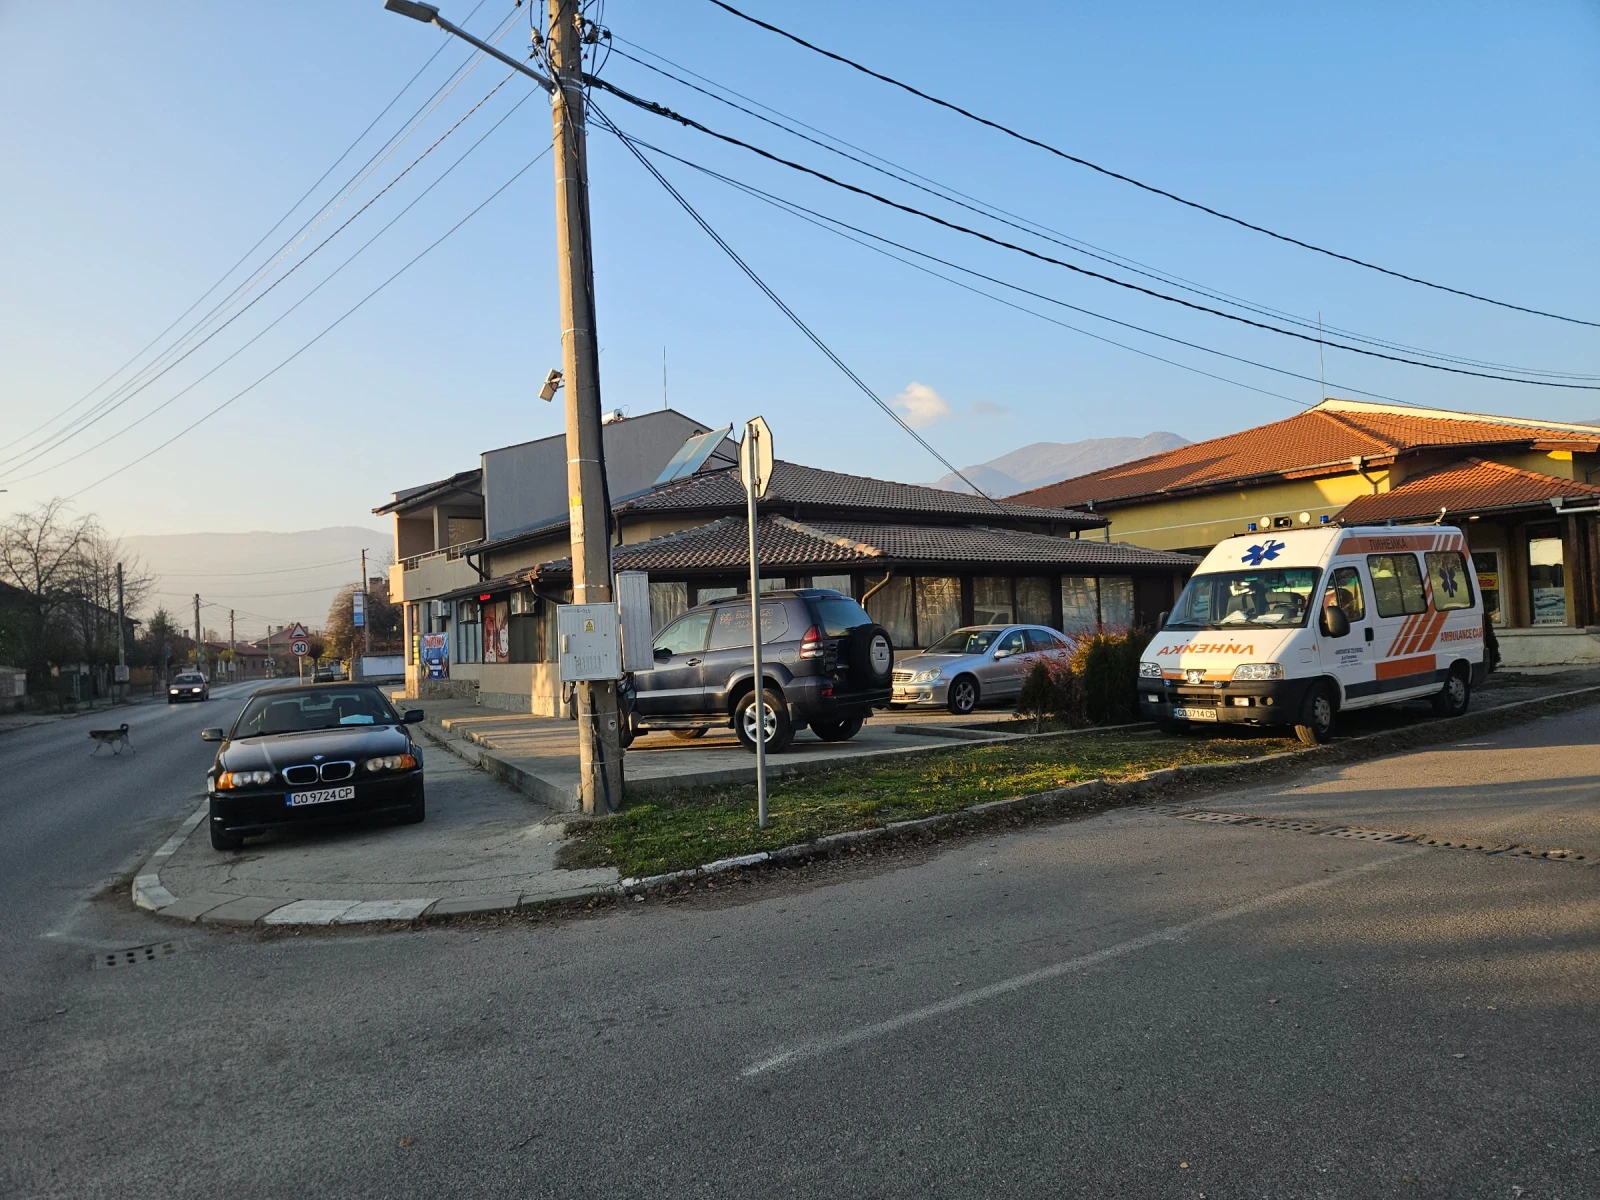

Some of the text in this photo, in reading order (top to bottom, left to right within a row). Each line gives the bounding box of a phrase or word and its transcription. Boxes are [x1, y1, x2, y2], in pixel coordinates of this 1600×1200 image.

[1441, 629, 1472, 642] AMBULANCE
[294, 643, 305, 653] 30
[293, 788, 352, 804] CO 9724 CP
